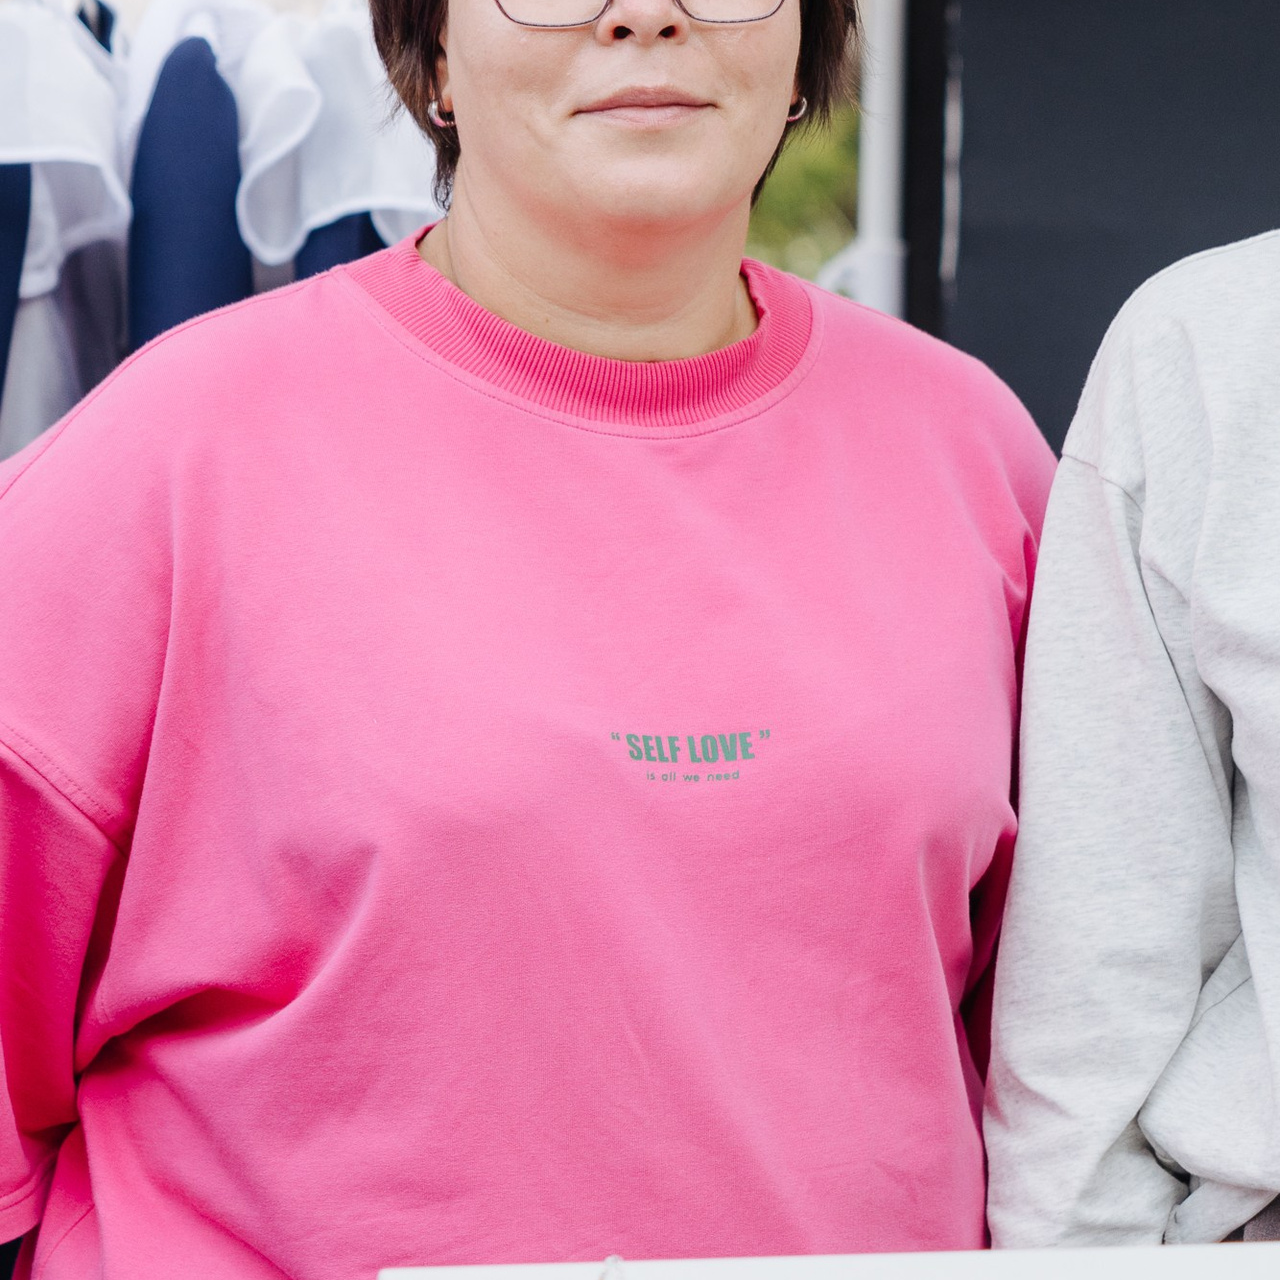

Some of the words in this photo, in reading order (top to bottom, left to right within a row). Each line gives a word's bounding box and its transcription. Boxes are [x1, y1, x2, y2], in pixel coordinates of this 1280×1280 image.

[646, 771, 656, 781] is
[661, 772, 676, 782] all
[683, 774, 700, 782] we
[706, 770, 740, 782] need
